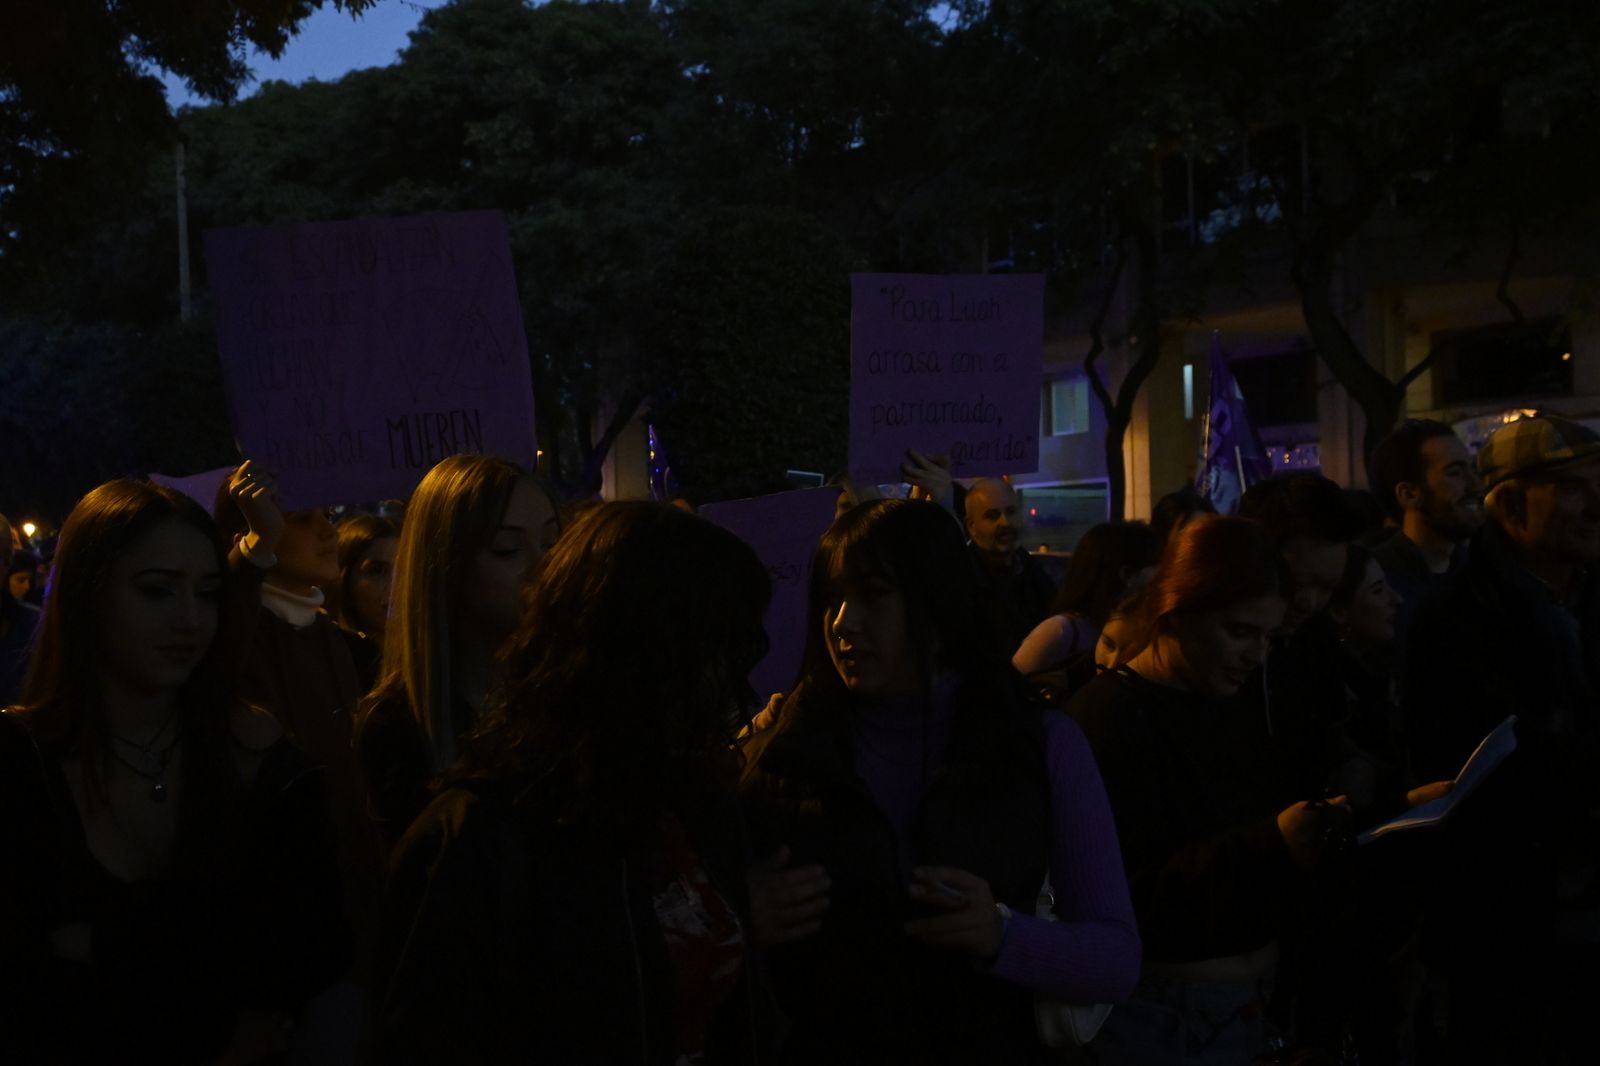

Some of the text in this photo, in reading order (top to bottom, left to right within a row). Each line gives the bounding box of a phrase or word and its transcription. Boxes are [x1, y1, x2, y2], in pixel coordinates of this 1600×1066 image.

[867, 349, 943, 375] arrasa
[950, 350, 984, 375] con
[870, 392, 1004, 434] patriarcado,
[384, 407, 484, 470] MUEREN
